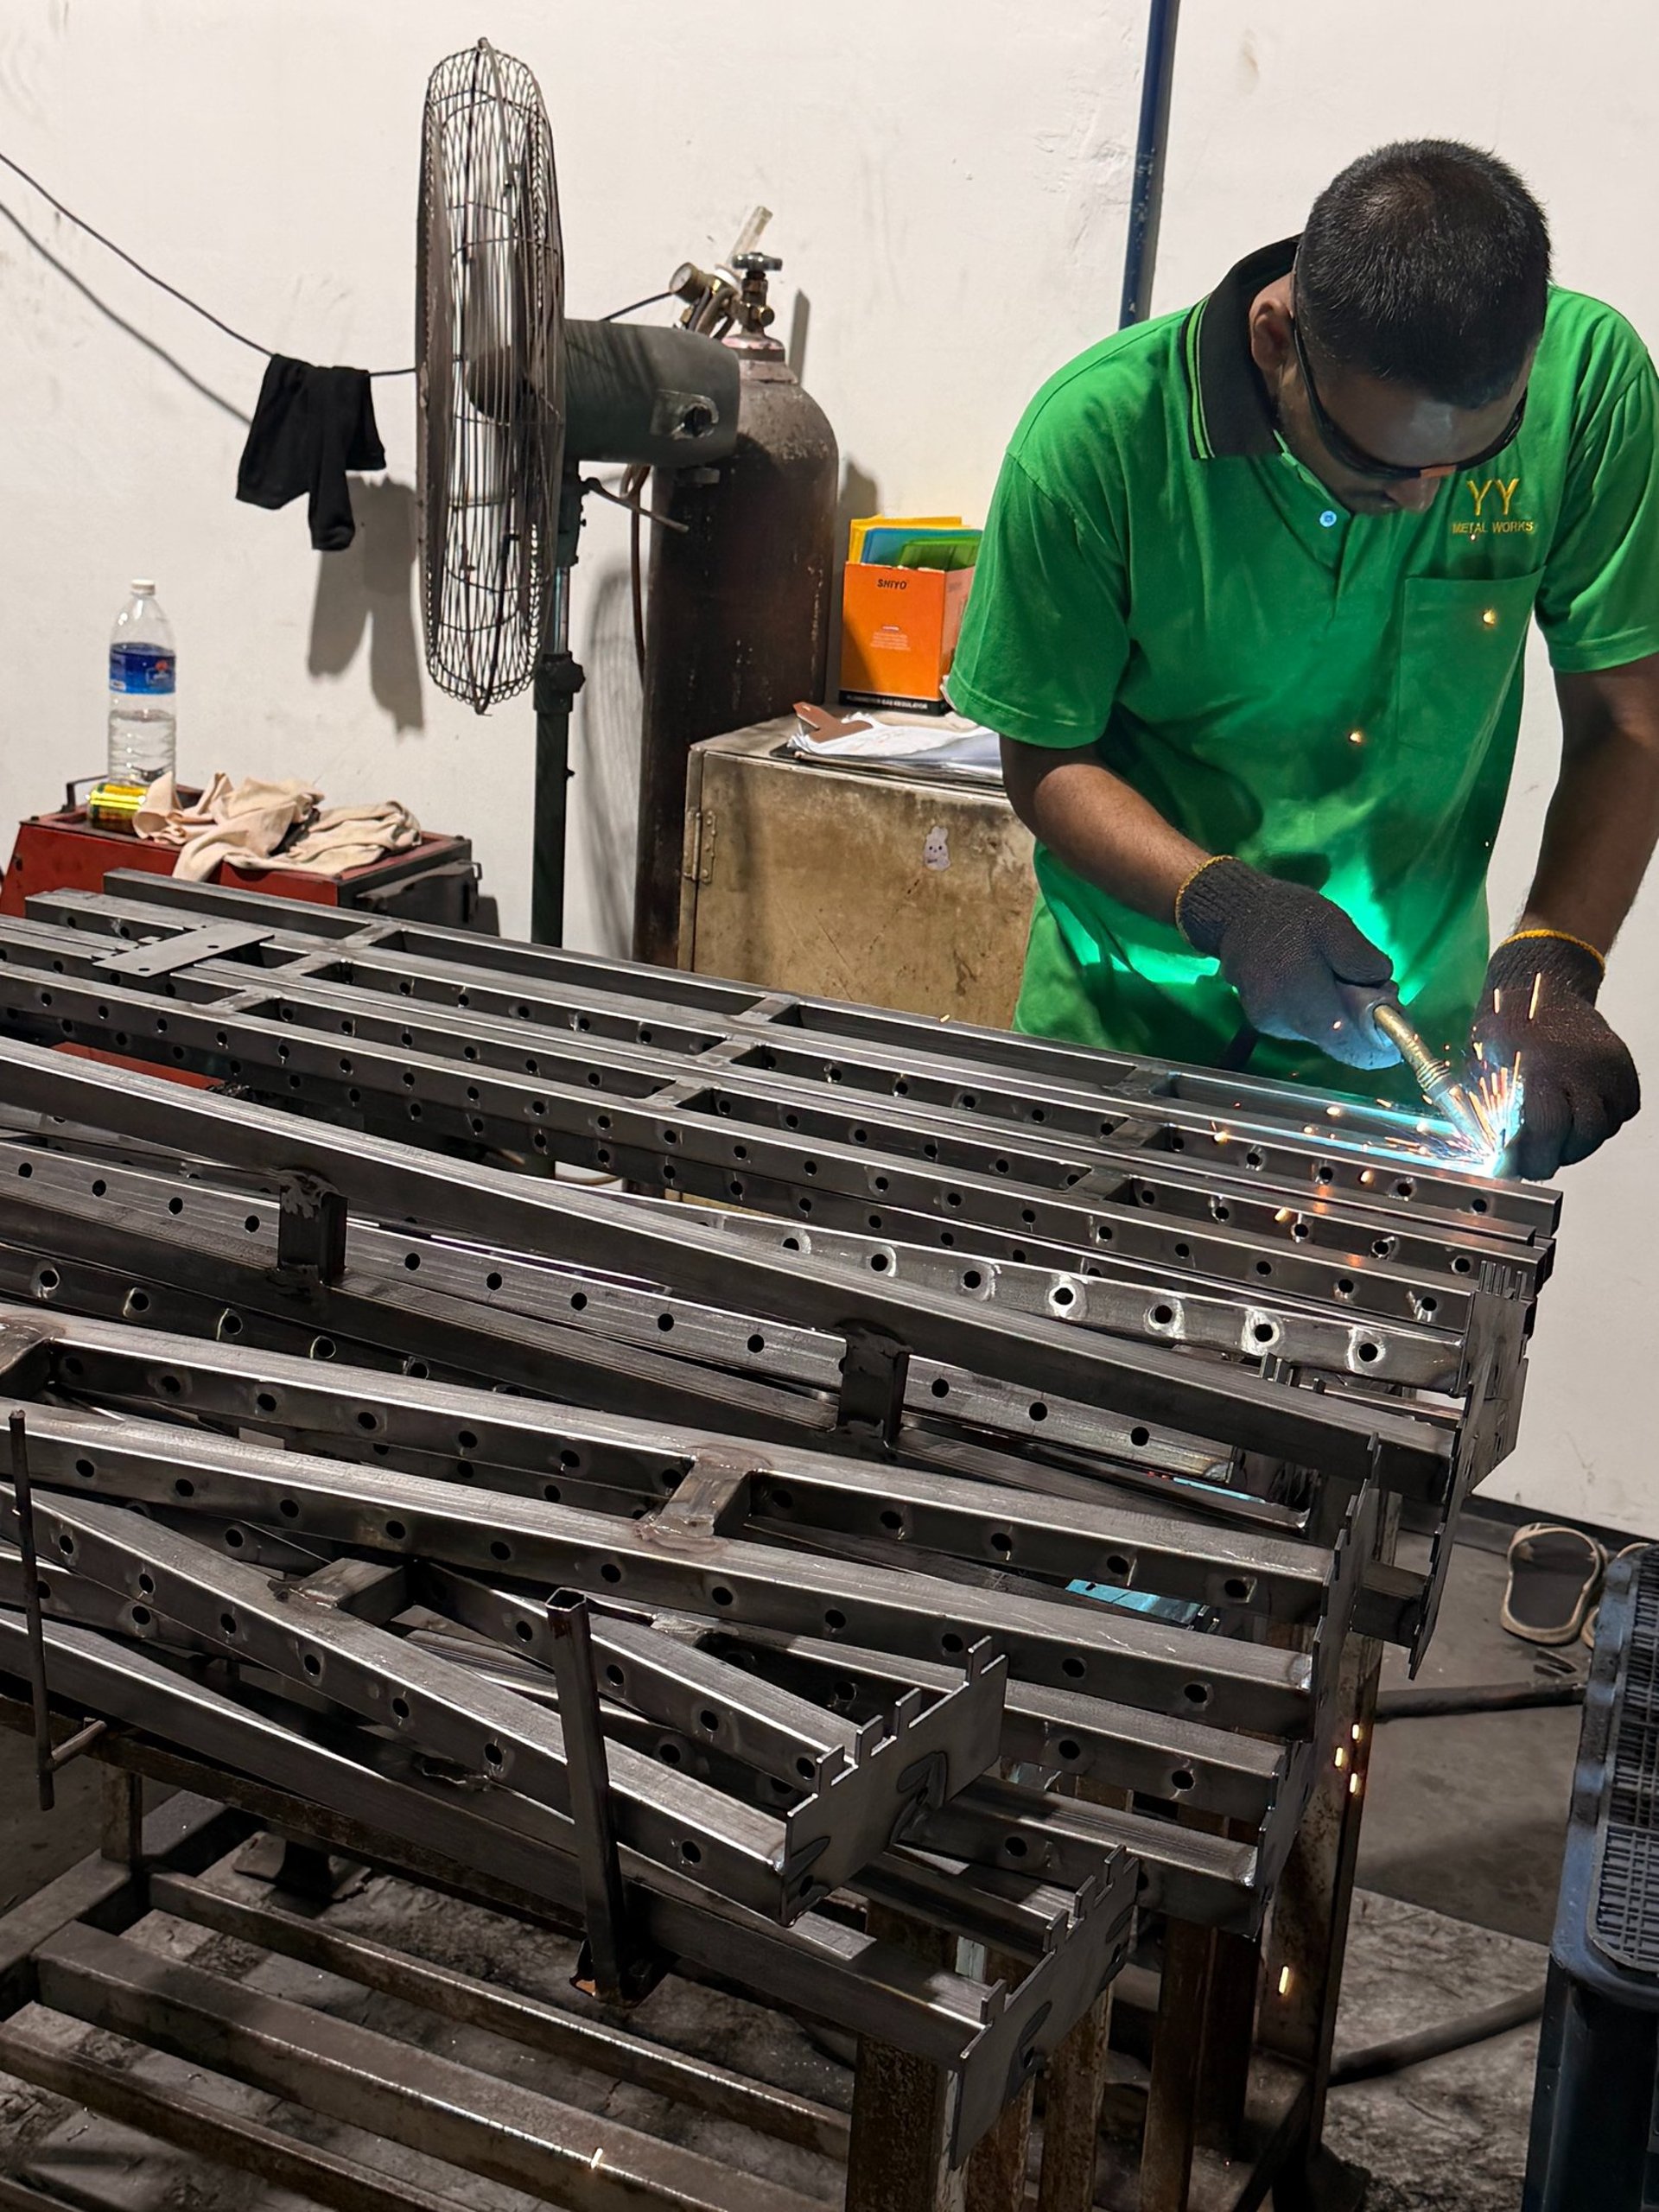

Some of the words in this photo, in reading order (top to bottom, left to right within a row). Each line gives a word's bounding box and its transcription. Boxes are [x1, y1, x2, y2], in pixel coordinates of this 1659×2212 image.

[1467, 478, 1520, 516] YY
[1452, 523, 1487, 534] METAL
[1492, 521, 1535, 533] WORKS
